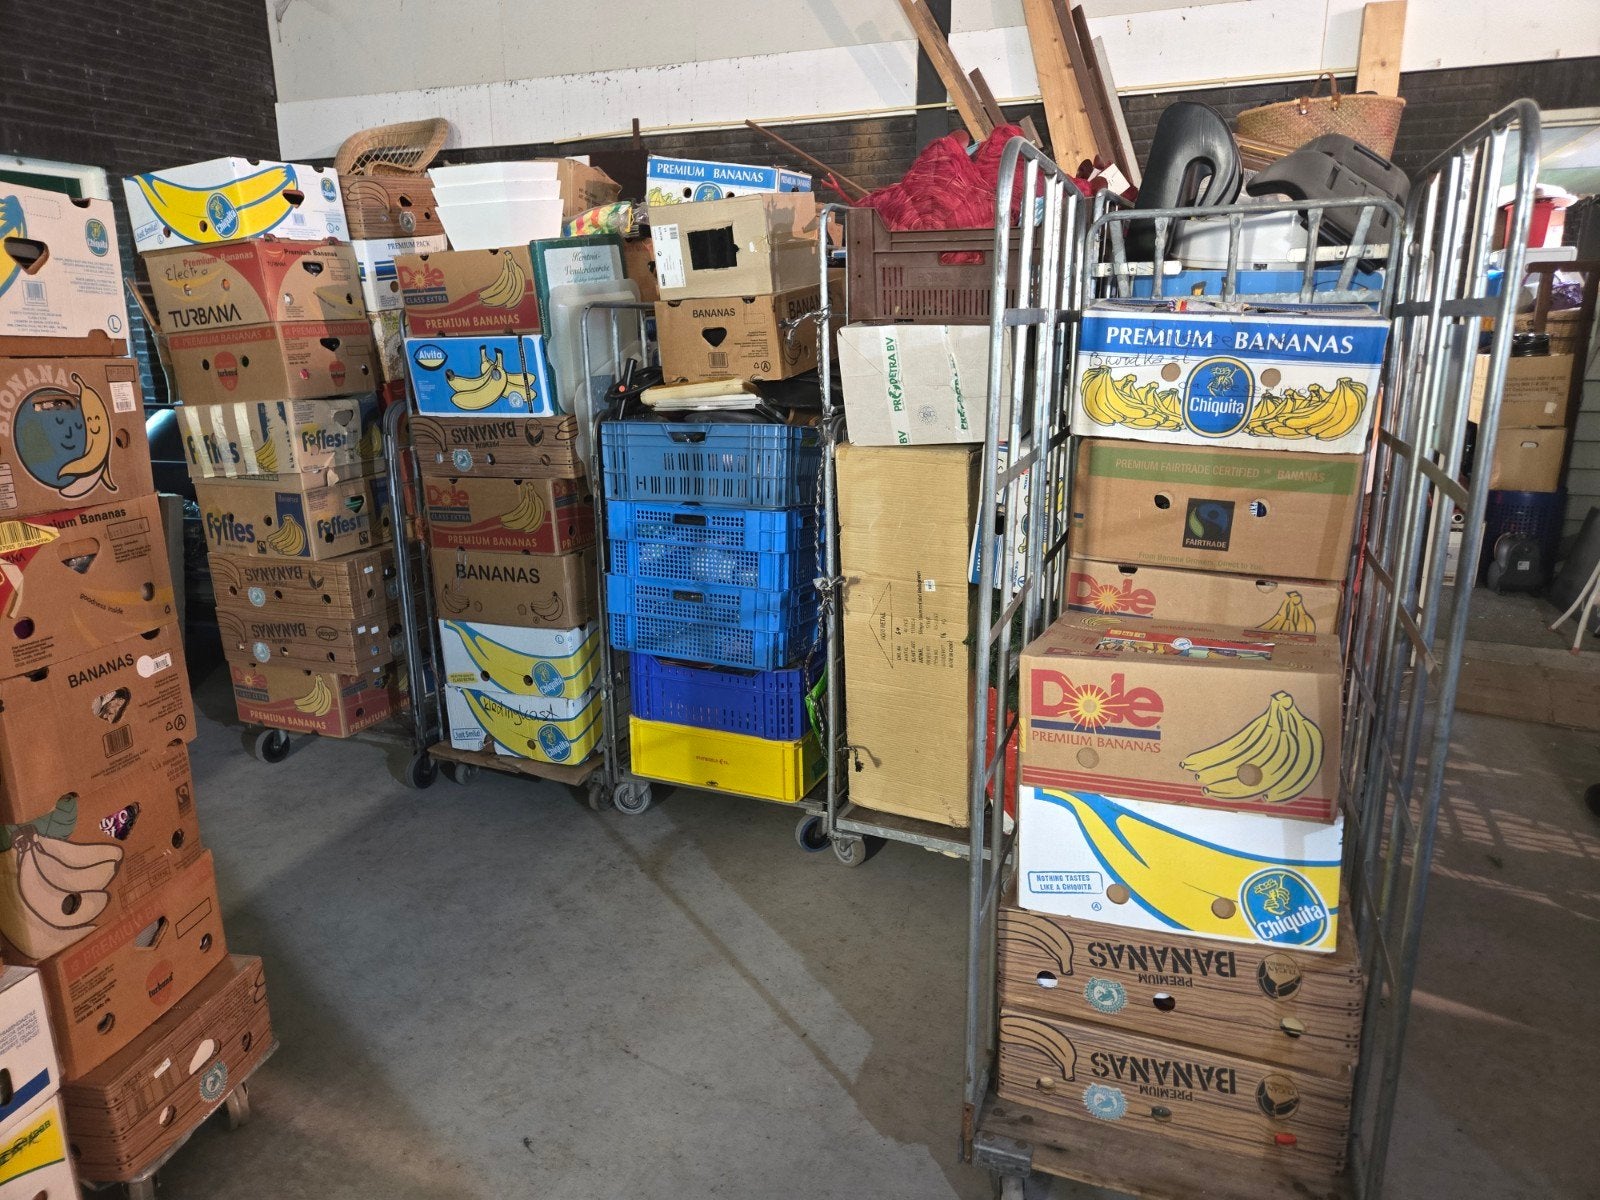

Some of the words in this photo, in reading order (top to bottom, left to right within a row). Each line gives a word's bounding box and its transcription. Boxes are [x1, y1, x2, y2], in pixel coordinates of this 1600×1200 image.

[657, 163, 705, 177] PREMIUM
[713, 168, 764, 183] BANANAS
[215, 209, 237, 235] Chiquita
[388, 240, 415, 249] PREMIUM
[416, 238, 430, 248] PACK
[183, 256, 217, 267] Premium
[219, 251, 254, 262] Bananas
[283, 249, 311, 257] Premium
[398, 263, 445, 288] Dole
[168, 303, 242, 328] TURBANA
[425, 316, 471, 329] PREMIUM
[473, 314, 520, 326] BANANAS
[692, 308, 736, 318] BANANAS
[183, 334, 220, 348] PREMIUM
[220, 331, 262, 343] BANANAS
[886, 337, 897, 351] BV
[1106, 327, 1213, 349] PREMIUM
[1235, 331, 1354, 355] BANANAS
[419, 351, 443, 360] Alvita
[1190, 396, 1244, 417] Chiquita
[452, 421, 517, 444] BANANAS
[898, 431, 908, 444] BV
[1115, 458, 1159, 471] PREMIUM
[1160, 461, 1211, 475] FAIRTRADE
[1212, 465, 1260, 478] CERTIFIED
[1277, 470, 1325, 483] BANANAS
[426, 485, 470, 506] Dole
[80, 507, 127, 525] Bananas
[449, 536, 490, 546] PREMIUM
[492, 537, 538, 547] BANANAS
[1185, 538, 1227, 549] FAIRTRADE
[1138, 552, 1155, 560] From
[1158, 553, 1184, 563] Banana
[244, 565, 303, 582] BANANAS
[456, 563, 541, 584] BANANAS
[80, 593, 106, 610] goodness
[108, 606, 123, 614] inside
[1070, 573, 1157, 616] Dole
[251, 623, 307, 638] BANANAS
[67, 653, 135, 689] BANANAS
[540, 678, 564, 695] Chiquita
[1030, 669, 1164, 728] Dole
[250, 711, 286, 725] PREMIUM
[287, 717, 327, 730] BANANAS
[350, 710, 388, 733] PREMIUM
[1032, 731, 1092, 747] PREMIUM
[1098, 737, 1161, 753] BANANAS
[1040, 883, 1054, 891] LIKE
[1062, 883, 1092, 891] CHIQUITA
[1065, 874, 1090, 882] TASTES
[1256, 903, 1325, 940] Chiquita
[1087, 941, 1237, 978] BANANAS
[1138, 973, 1194, 988] PREMIUM
[1091, 1051, 1237, 1095] BANANAS
[1139, 1084, 1194, 1101] PREMIUM
